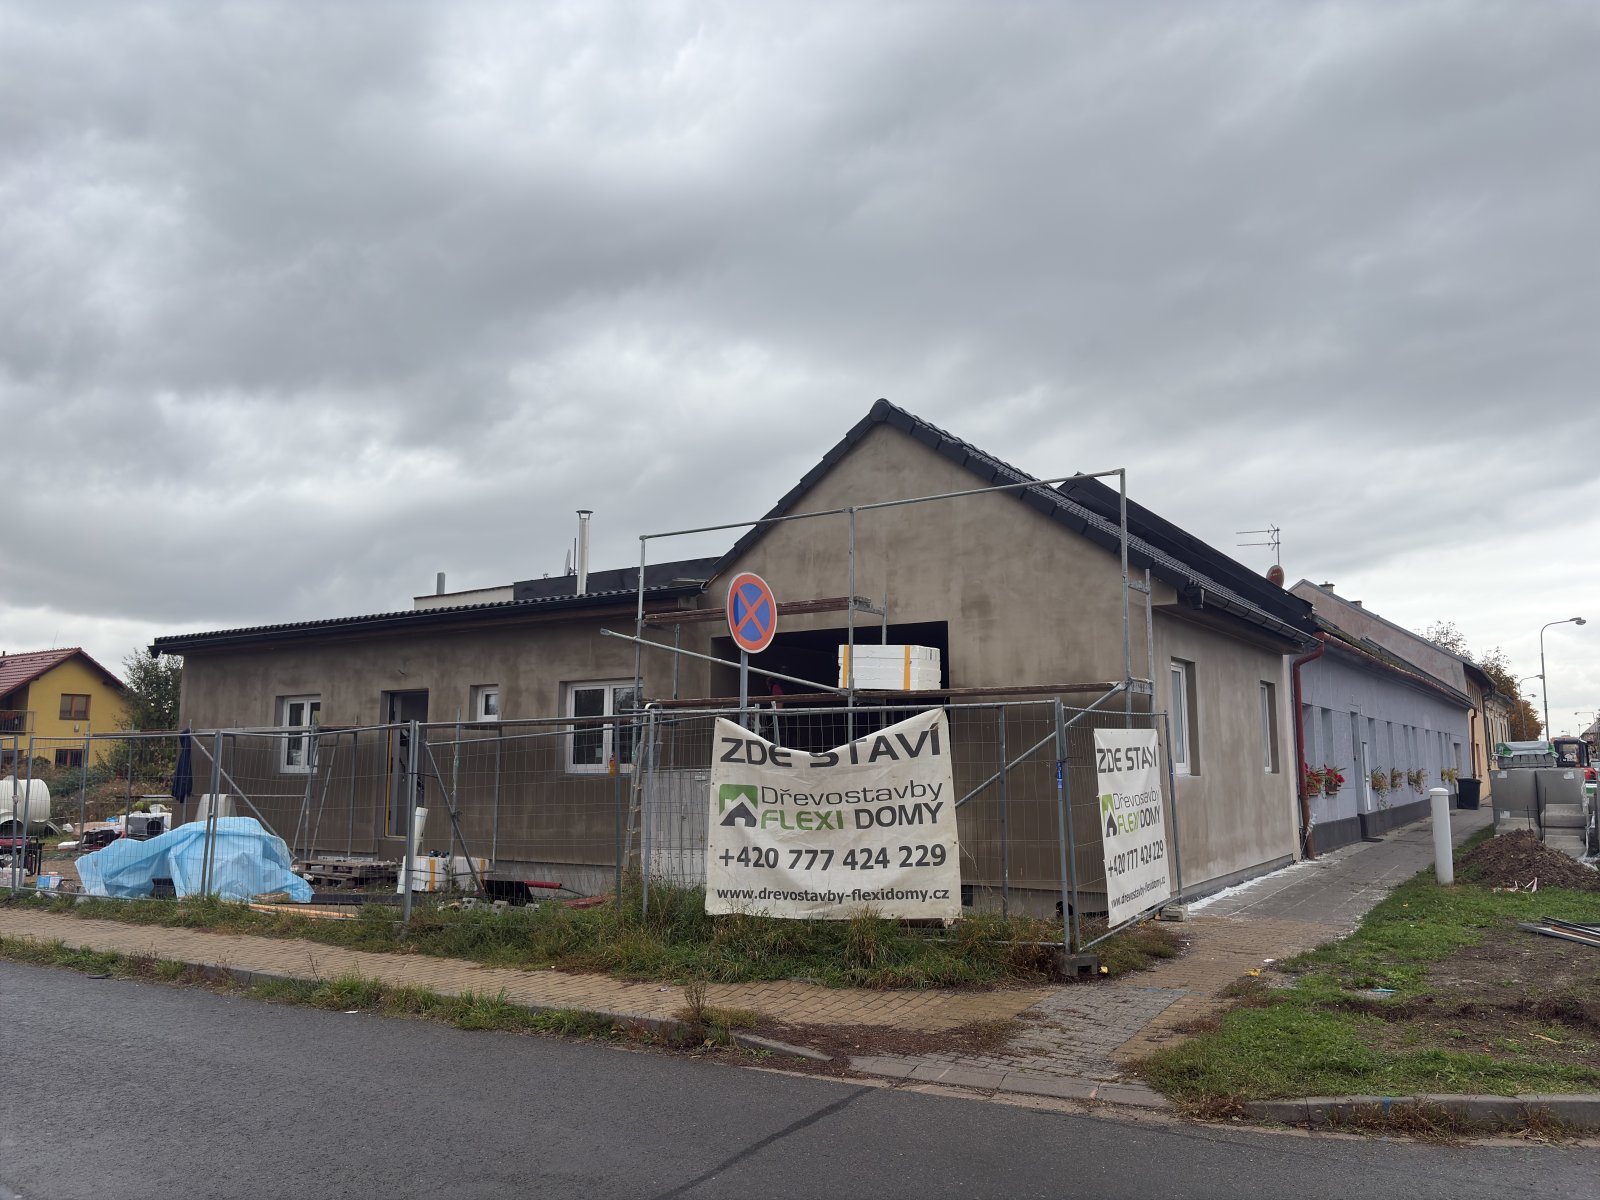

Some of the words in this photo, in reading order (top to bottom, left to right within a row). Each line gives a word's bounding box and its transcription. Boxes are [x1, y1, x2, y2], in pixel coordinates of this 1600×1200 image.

[720, 737, 792, 768] ZDE
[1097, 747, 1122, 773] ZDE
[761, 780, 943, 806] Dřevostavby
[1112, 788, 1159, 811] Dřevostavby
[761, 809, 844, 831] FLEXI
[855, 801, 944, 830] DOMY
[1117, 812, 1139, 836] FLEXI
[1139, 805, 1161, 828] DOMY
[719, 846, 779, 869] +420
[788, 848, 835, 871] 777
[842, 847, 891, 870] 424
[898, 844, 947, 868] 229
[1108, 851, 1126, 878] +420
[1127, 847, 1138, 871] 777
[1140, 843, 1152, 867] 424
[1152, 839, 1164, 860] 229
[717, 887, 950, 904] www.drevostavby-flexidomy.cz
